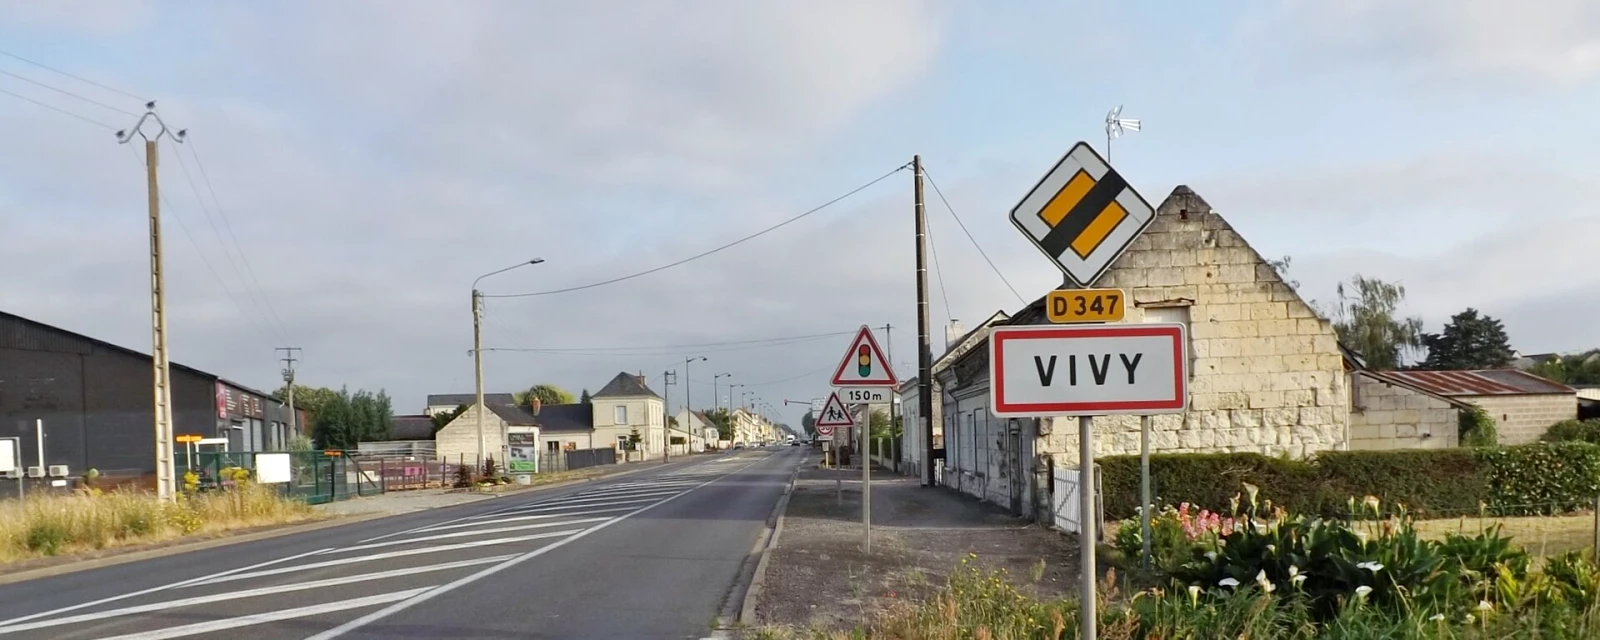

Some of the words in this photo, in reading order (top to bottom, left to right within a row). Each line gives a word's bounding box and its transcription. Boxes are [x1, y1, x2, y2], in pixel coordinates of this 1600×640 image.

[1053, 296, 1068, 317] D
[1074, 295, 1120, 316] 347
[1034, 353, 1143, 387] VIVY
